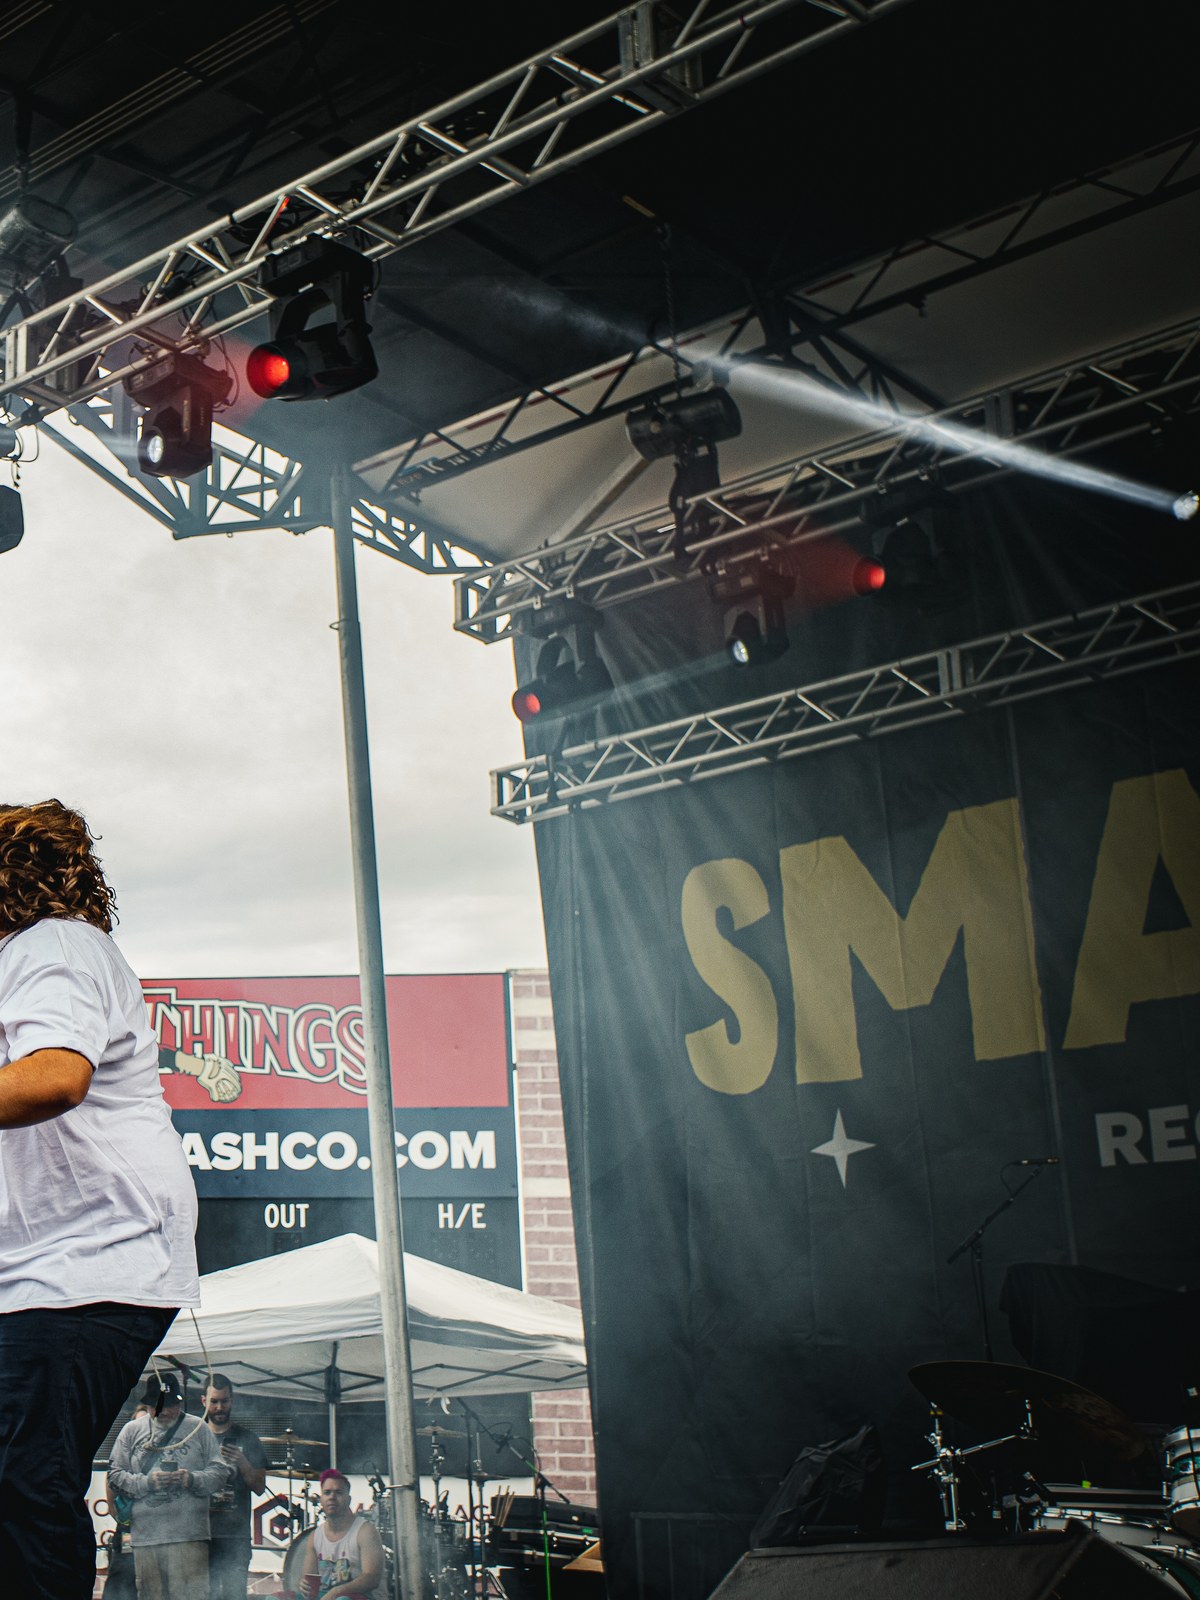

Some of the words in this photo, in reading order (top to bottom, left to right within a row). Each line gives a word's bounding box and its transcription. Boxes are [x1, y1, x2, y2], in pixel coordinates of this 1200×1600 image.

[1095, 1104, 1200, 1168] RE
[264, 1203, 309, 1229] OUT
[438, 1203, 487, 1229] H/E
